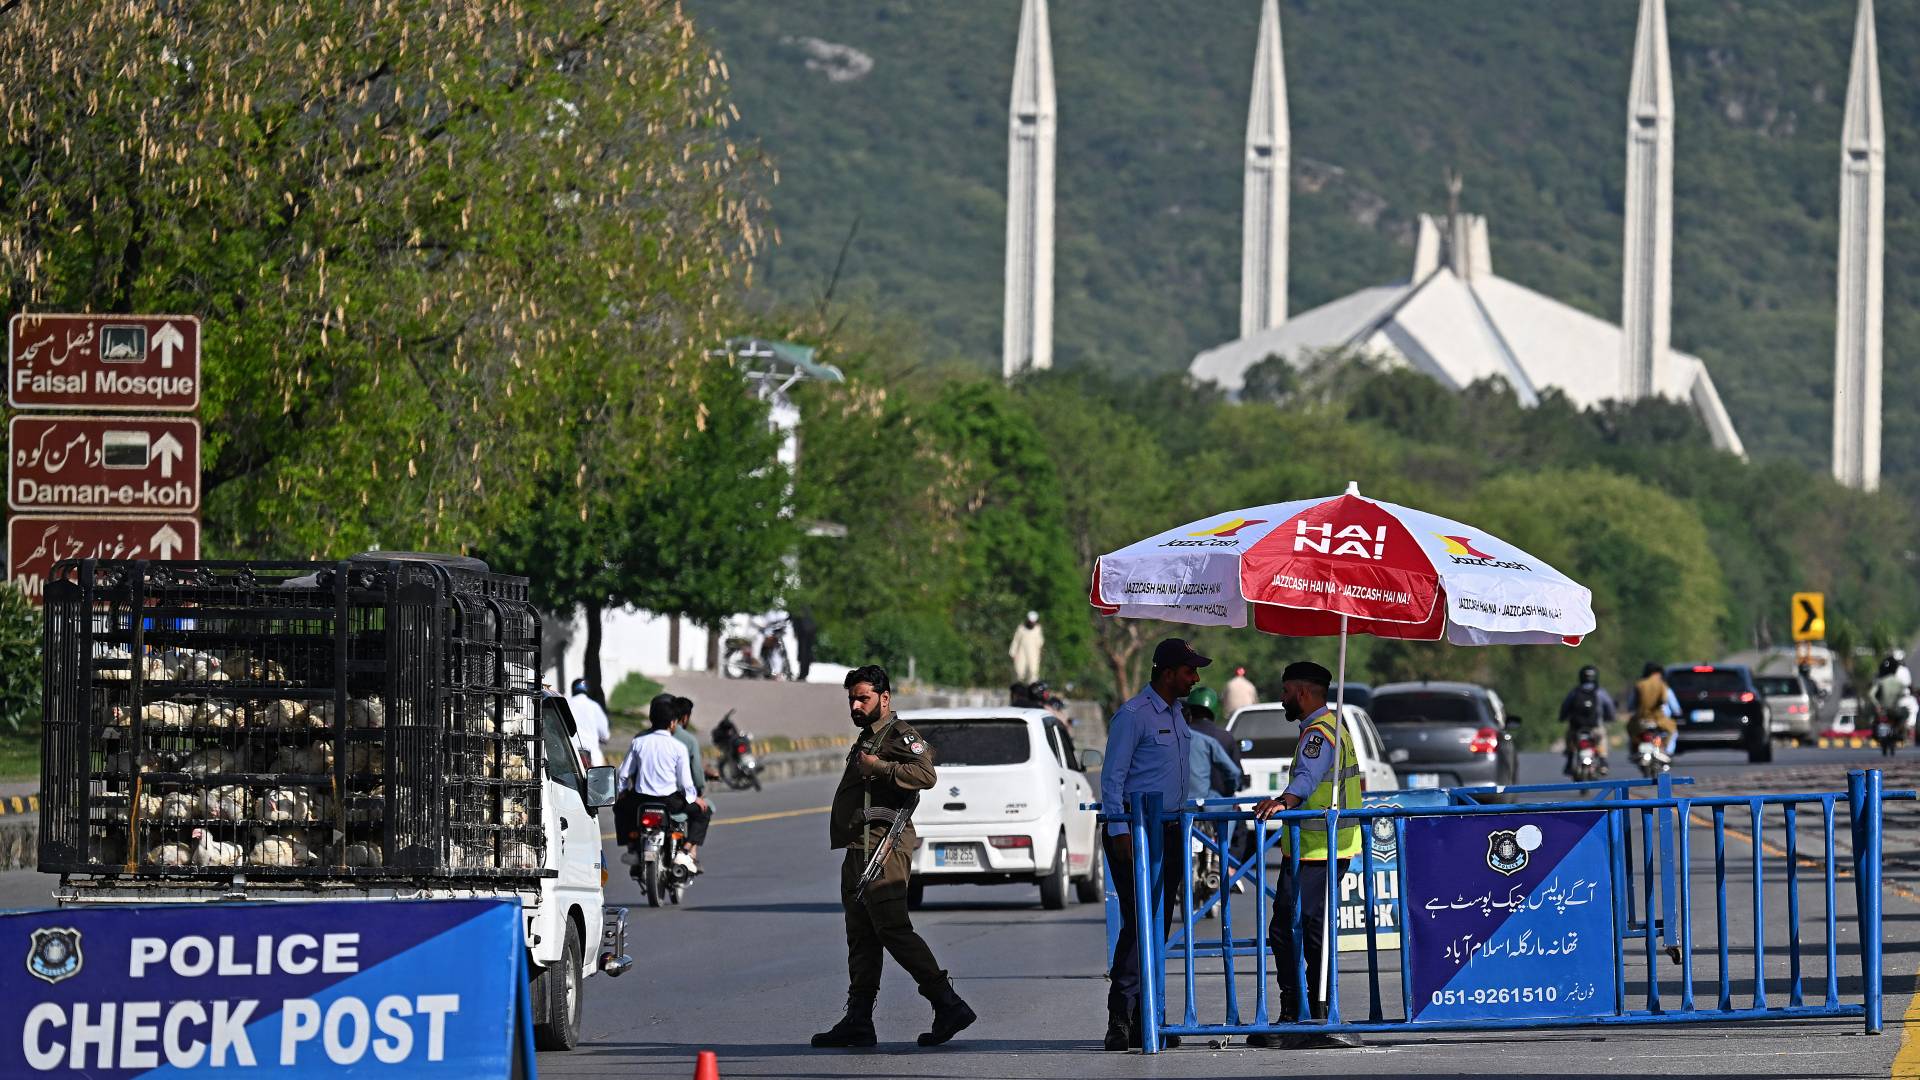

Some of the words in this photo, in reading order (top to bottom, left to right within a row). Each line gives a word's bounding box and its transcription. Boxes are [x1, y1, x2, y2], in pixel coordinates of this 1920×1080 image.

[16, 333, 56, 368] مسجد
[50, 322, 94, 367] فیصل
[17, 369, 87, 393] Faisal
[95, 370, 194, 399] Mosque
[16, 424, 57, 468] کوہ
[44, 432, 101, 473] دامن
[18, 478, 193, 505] Daman-e-koh
[1158, 538, 1239, 547] JazzCash
[1449, 555, 1532, 572] JazzCash
[1125, 582, 1155, 594] JAZZCASH
[1180, 583, 1208, 595] JAZZCASH
[1272, 574, 1309, 592] JAZZCASH
[1310, 579, 1323, 594] HAI
[1325, 582, 1336, 594] NA
[1342, 585, 1382, 601] JAZZCASH
[1383, 590, 1396, 603] HAI
[1397, 593, 1412, 605] NA!
[1502, 605, 1536, 616] JAZZCASH
[1450, 890, 1491, 917] پوسٹ
[1492, 883, 1526, 913] چیک
[1529, 876, 1567, 914] پولیس
[1564, 879, 1597, 906] آگے
[1425, 897, 1449, 919] ہے
[129, 932, 360, 978] POLICE
[1443, 933, 1473, 965] آباد
[1470, 937, 1510, 968] اسلام
[1508, 929, 1545, 957] مارگلہ
[1547, 932, 1578, 956] تھانہ
[1431, 986, 1557, 1006] 051-9261510
[1564, 982, 1580, 1002] نمبر
[1577, 983, 1595, 1001] فون
[23, 998, 260, 1071] CHECK
[280, 994, 459, 1067] POST
